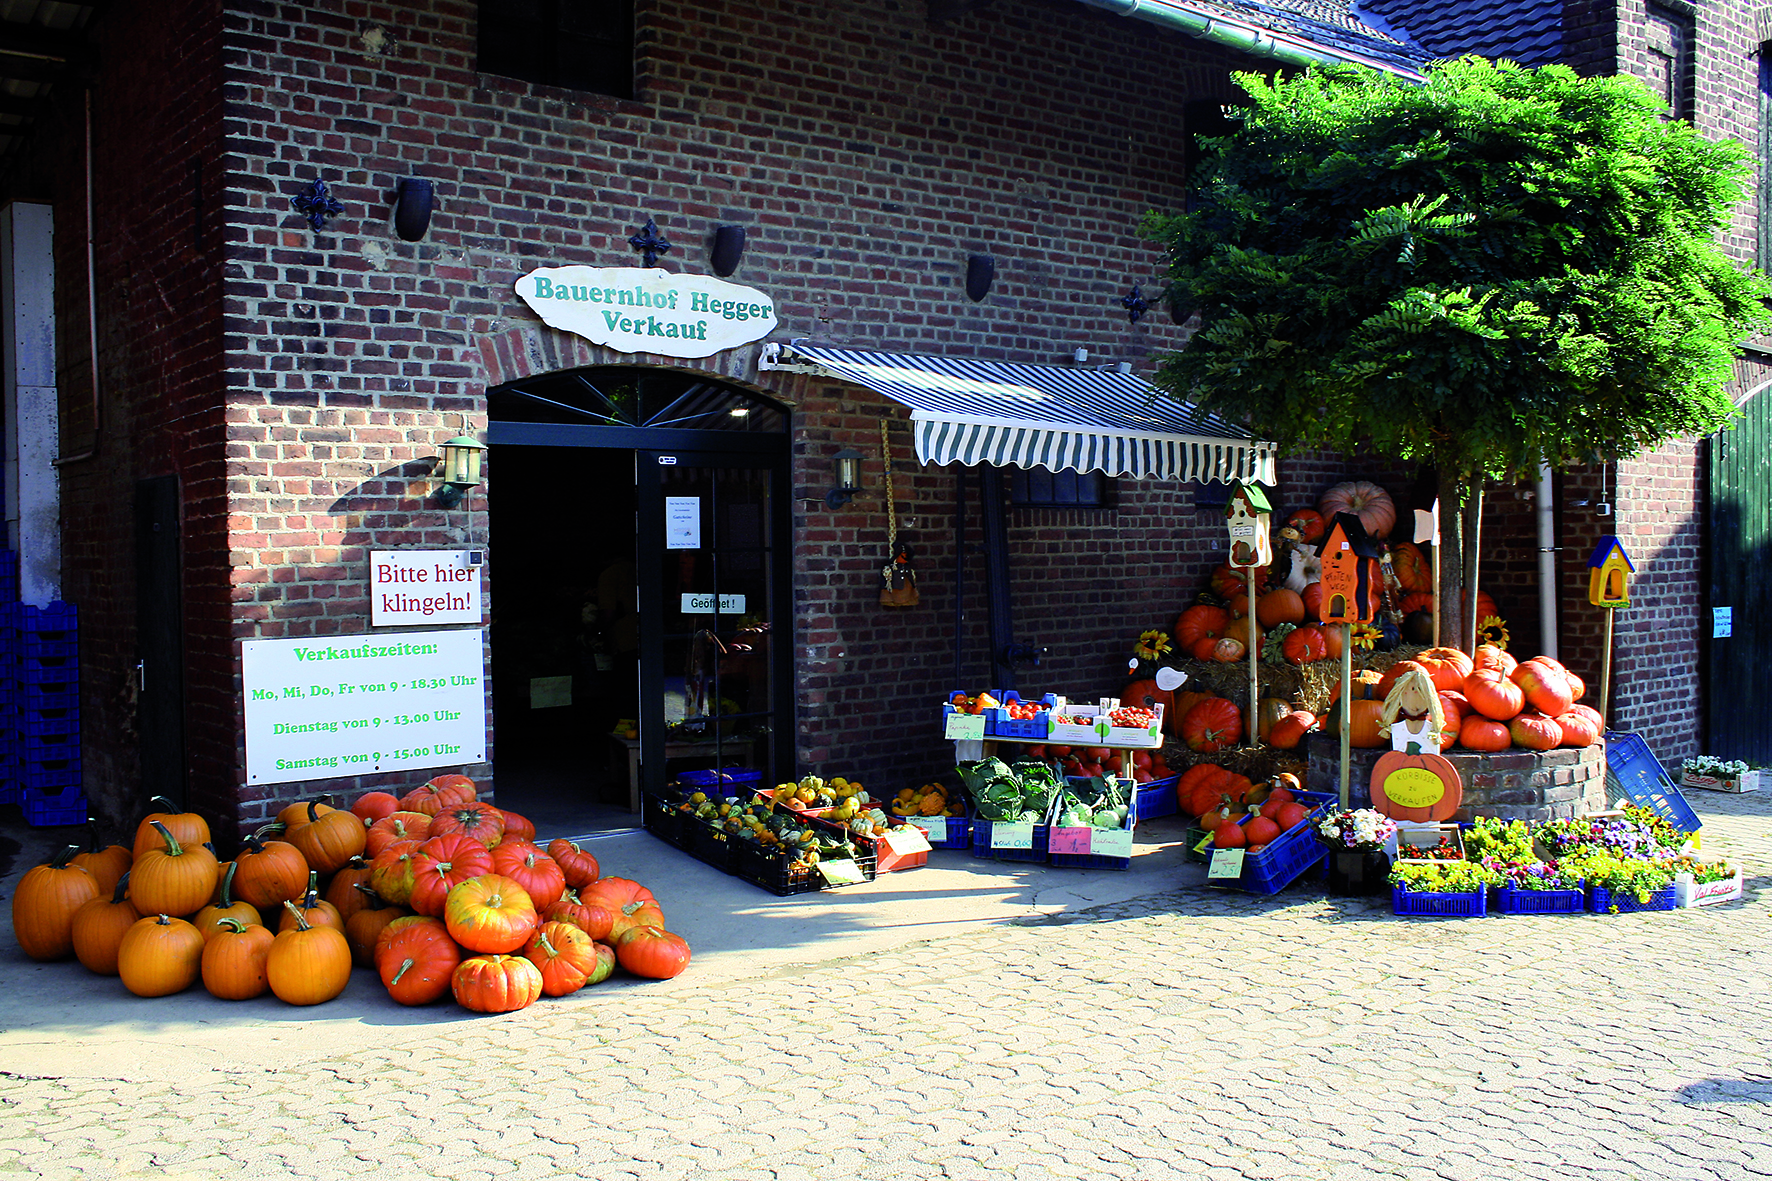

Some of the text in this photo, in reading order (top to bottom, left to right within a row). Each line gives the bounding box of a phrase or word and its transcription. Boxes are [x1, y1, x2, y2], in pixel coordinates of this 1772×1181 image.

[534, 276, 773, 321] Bauernhof Hegger
[601, 309, 708, 341] Verkauf
[377, 563, 475, 583] Bitte hier
[381, 591, 471, 616] klingeln!
[294, 642, 438, 662] Verkaufszeiten:
[251, 688, 279, 702] Mo,
[283, 686, 306, 700] Mi,
[310, 684, 335, 698] Do,
[338, 683, 356, 695] Fr
[359, 681, 386, 694] von
[389, 681, 398, 694] 9
[410, 678, 447, 691] 18.30
[450, 675, 477, 687] Uhr
[273, 720, 338, 735] Dienstag
[342, 717, 369, 729] von
[372, 716, 381, 729] 9
[393, 713, 430, 727] 13.00
[434, 710, 461, 722] Uhr
[275, 755, 338, 771] Samstag
[342, 753, 369, 765] von
[372, 751, 381, 763] 9
[393, 747, 430, 761] 15.00
[434, 743, 461, 756] Uhr
[1388, 790, 1438, 805] VERKAUFEN
